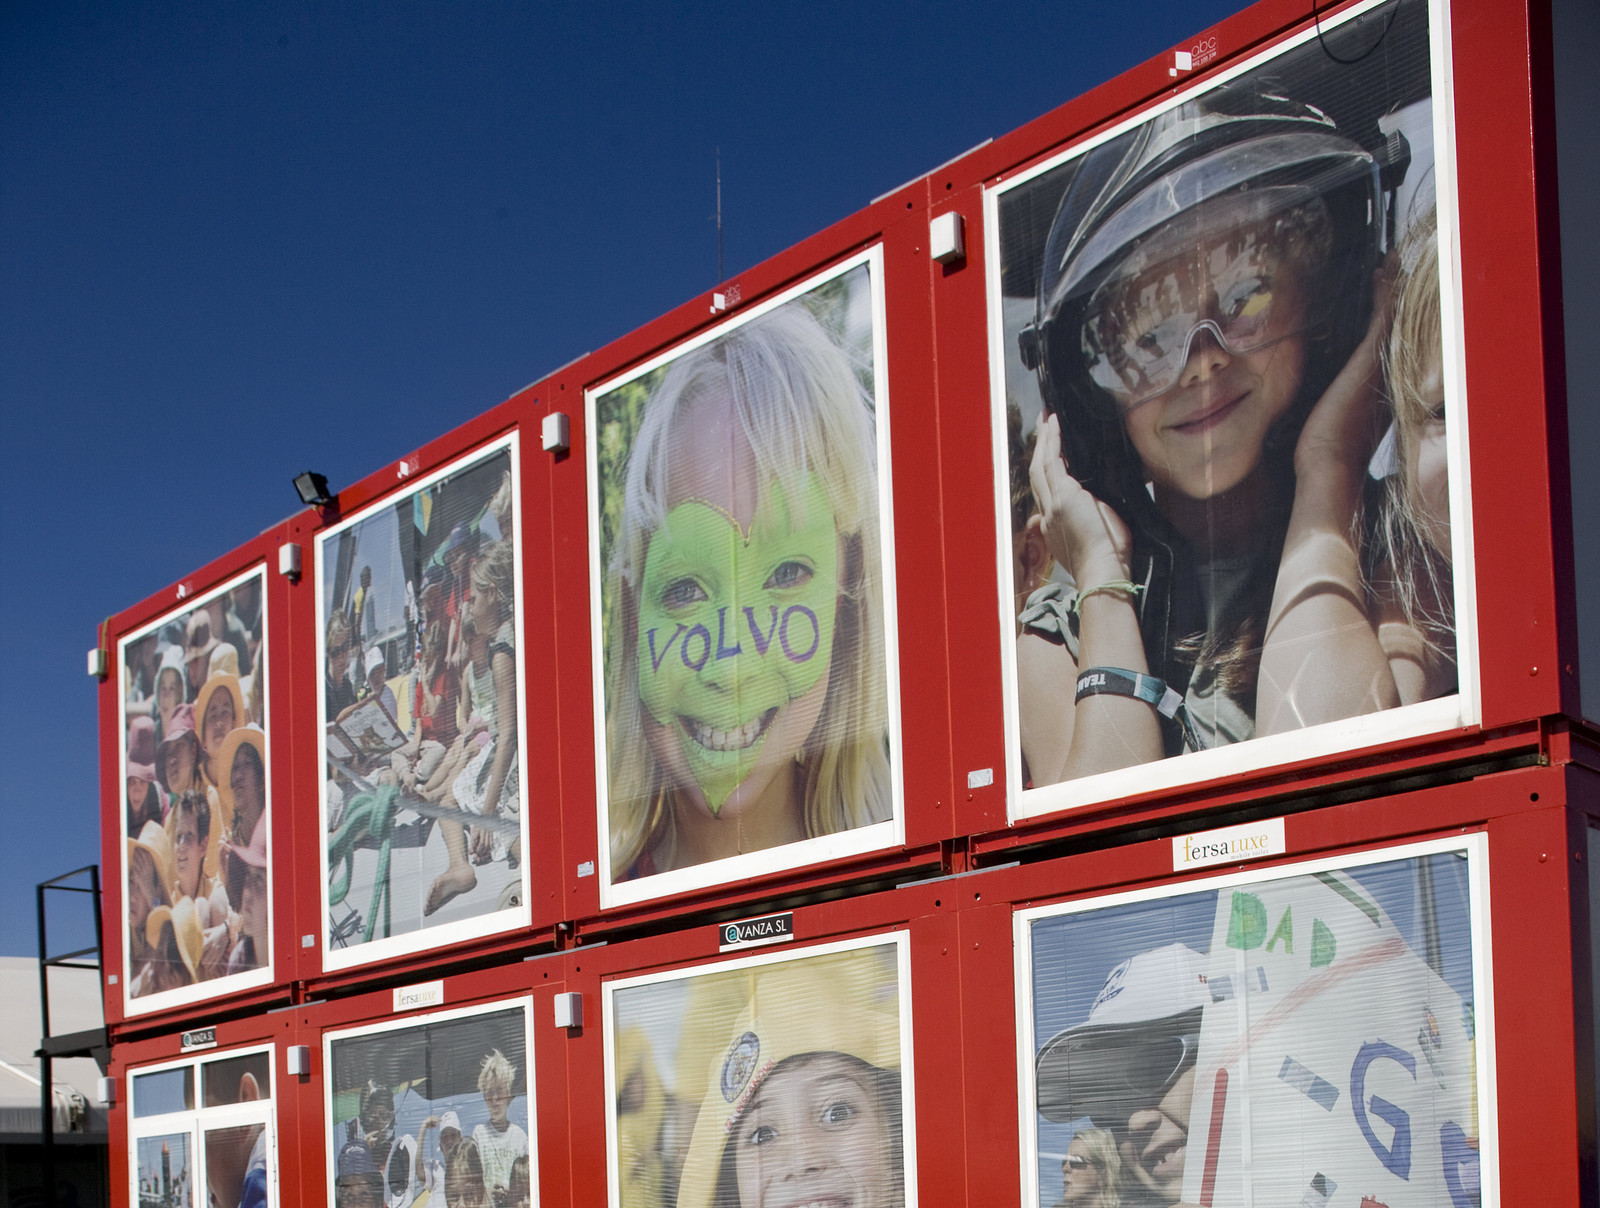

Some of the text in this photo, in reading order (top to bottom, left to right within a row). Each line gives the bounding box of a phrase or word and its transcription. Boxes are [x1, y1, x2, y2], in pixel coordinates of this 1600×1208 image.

[1191, 36, 1216, 58] abc
[645, 604, 819, 674] VOLVO
[775, 919, 787, 933] SL
[1225, 890, 1338, 969] DAD
